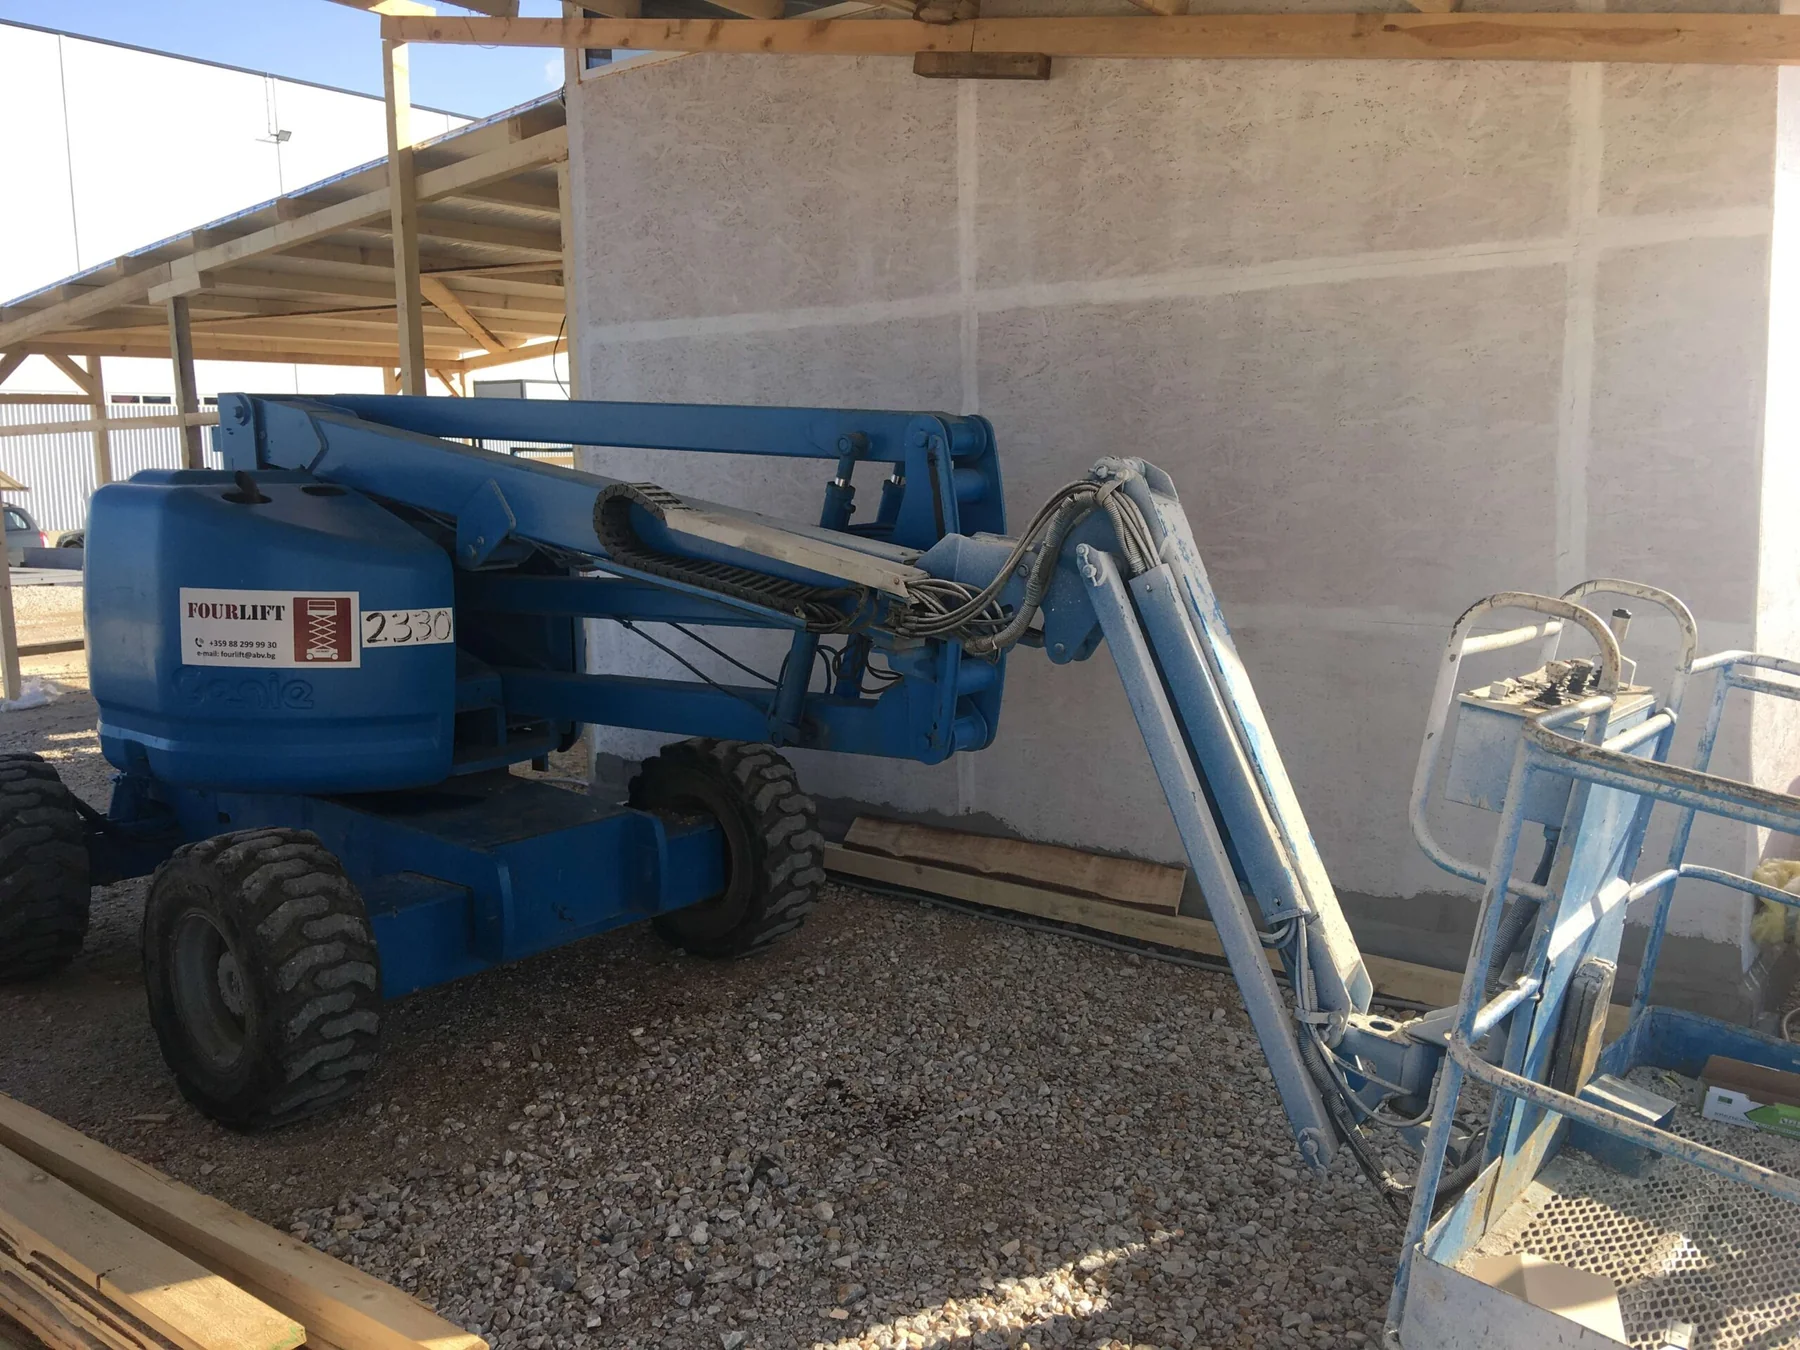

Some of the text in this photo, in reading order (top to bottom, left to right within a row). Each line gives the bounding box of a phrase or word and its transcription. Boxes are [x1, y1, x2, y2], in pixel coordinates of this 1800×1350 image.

[187, 602, 285, 621] FOURLIFT
[365, 610, 451, 643] 2330
[209, 639, 277, 649] +359 88 299 99 30
[220, 651, 276, 660] fourlift@abv.bg
